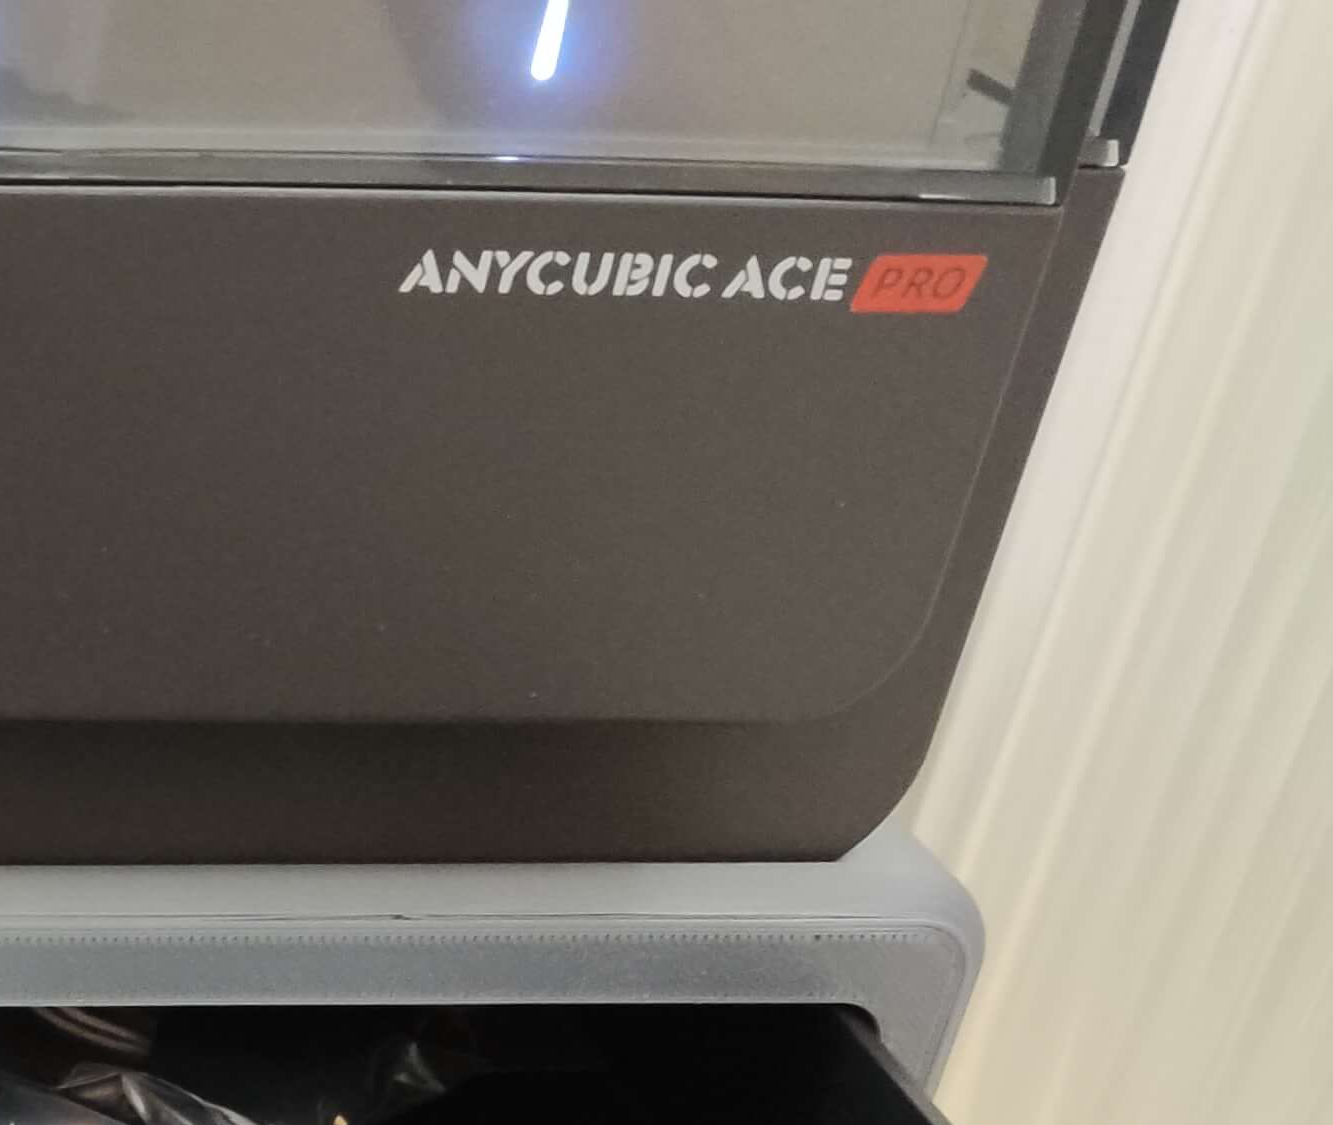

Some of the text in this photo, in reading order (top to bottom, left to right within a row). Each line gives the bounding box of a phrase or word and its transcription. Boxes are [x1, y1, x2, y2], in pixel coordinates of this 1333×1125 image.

[398, 248, 967, 301] ANYCUBIC ACE PRO
